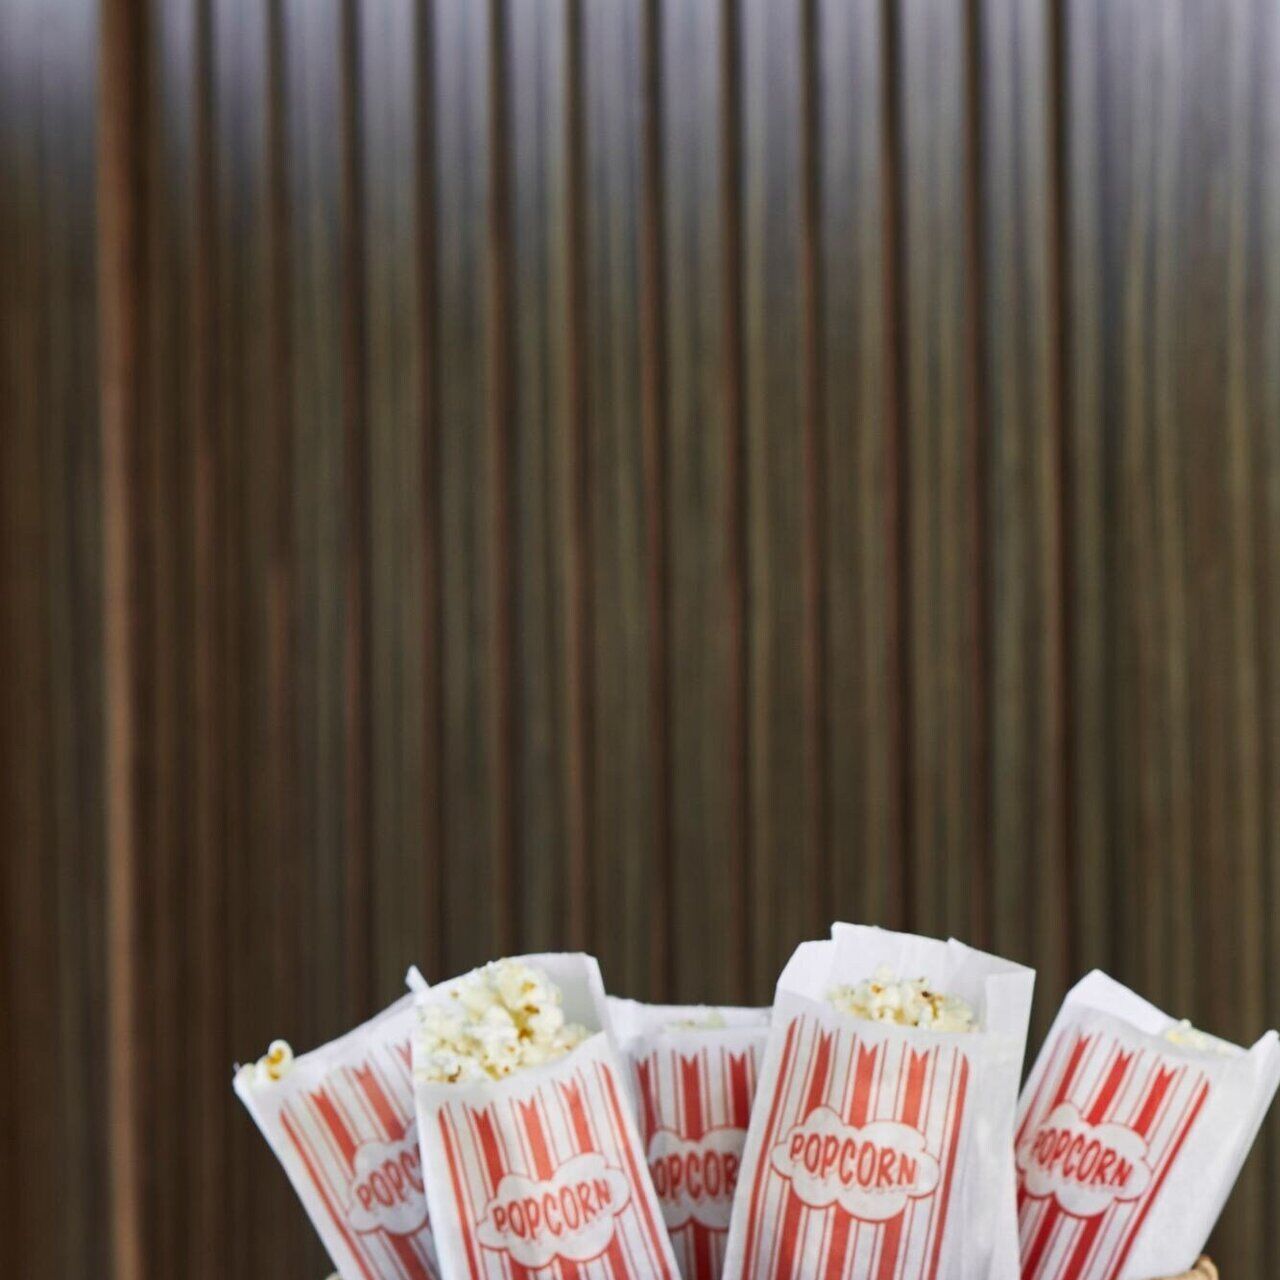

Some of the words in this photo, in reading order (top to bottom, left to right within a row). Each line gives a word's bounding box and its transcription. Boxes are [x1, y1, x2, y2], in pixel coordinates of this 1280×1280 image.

[355, 1148, 424, 1211] POPC
[649, 1149, 738, 1199] OPCOR
[789, 1133, 917, 1188] POPCORN
[1031, 1127, 1133, 1188] POPCORN
[493, 1178, 612, 1240] POPCORN
